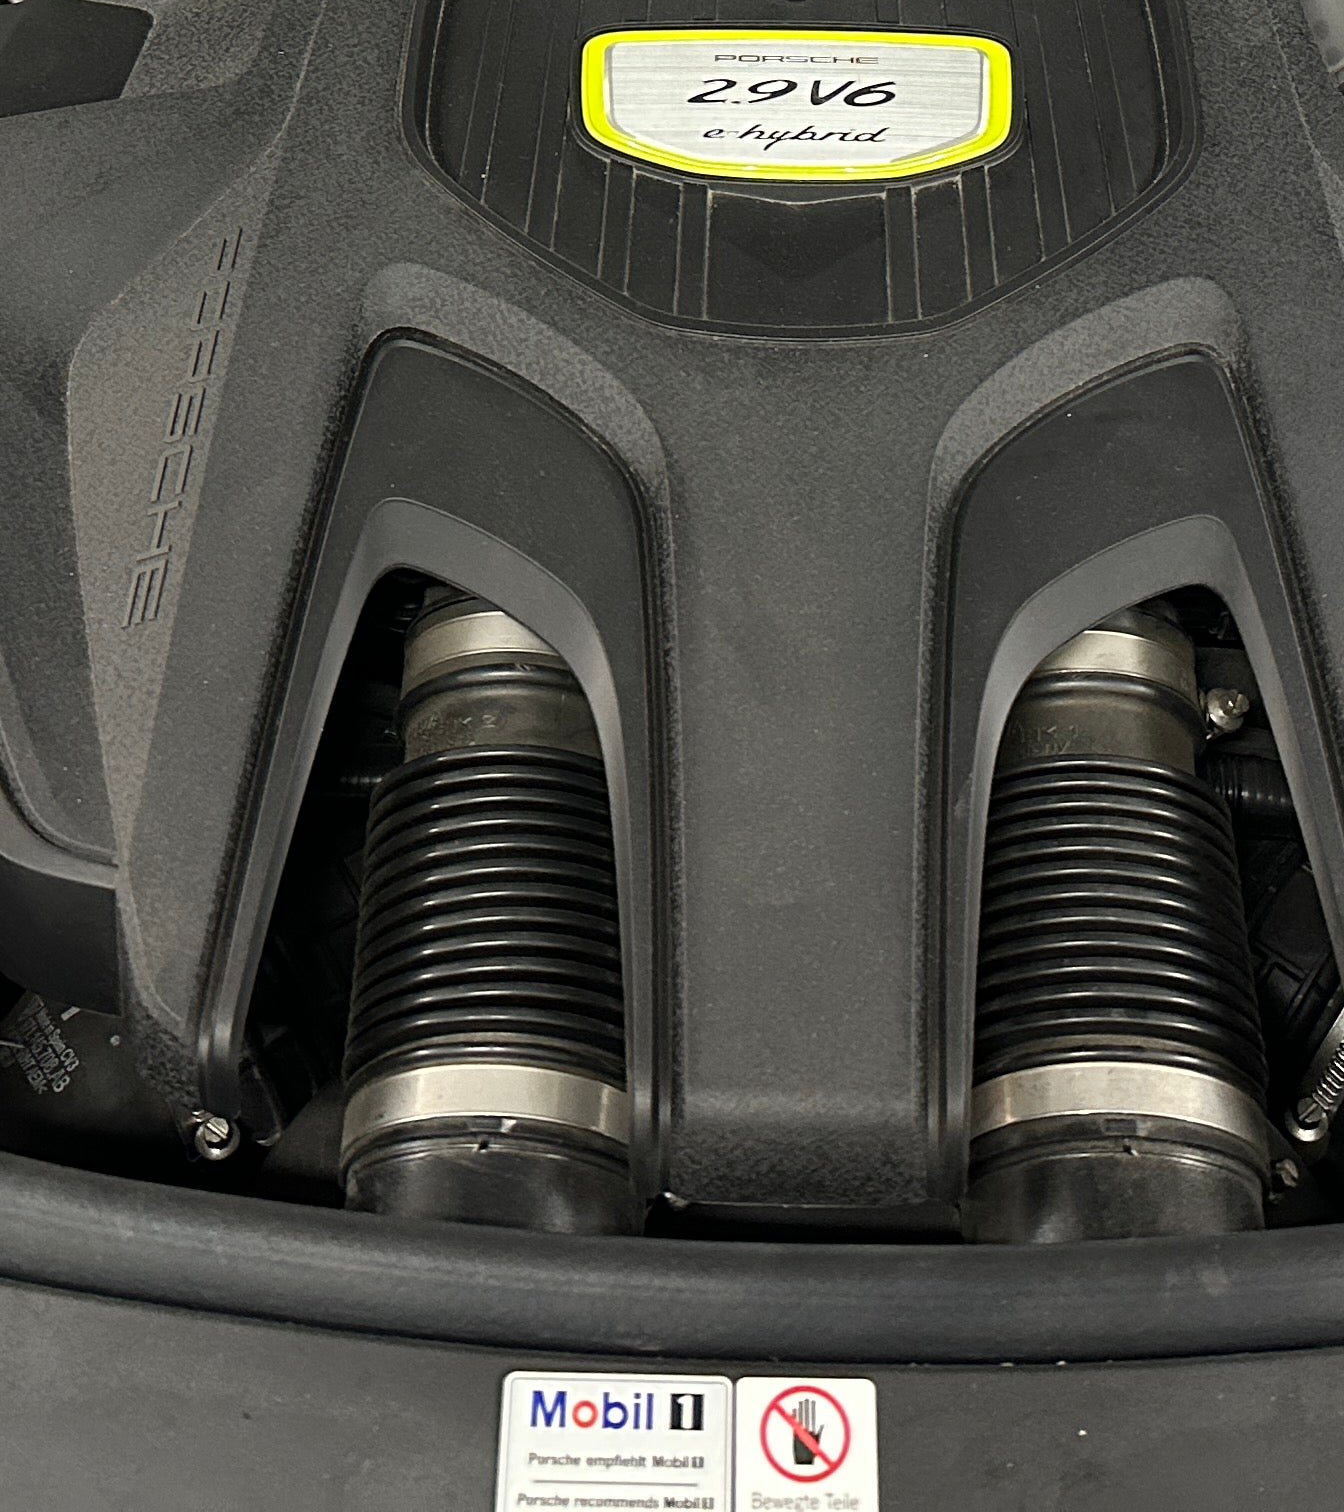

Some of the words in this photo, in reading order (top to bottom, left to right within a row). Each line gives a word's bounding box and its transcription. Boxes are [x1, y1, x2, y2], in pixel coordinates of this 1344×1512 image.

[714, 54, 879, 65] PORSCHE
[703, 124, 888, 151] e-hybrid
[120, 226, 244, 630] PORSCHE
[529, 1390, 654, 1431] Mobil
[674, 1394, 702, 1431] 1
[528, 1452, 581, 1466] Porsche
[586, 1454, 646, 1469] empfiehlt
[652, 1455, 689, 1468] Mobil
[516, 1493, 570, 1507] Porsche
[574, 1496, 659, 1510] recommends
[663, 1497, 700, 1510] Mobil
[751, 1491, 820, 1512] Bewegte
[824, 1492, 860, 1510] Teile
